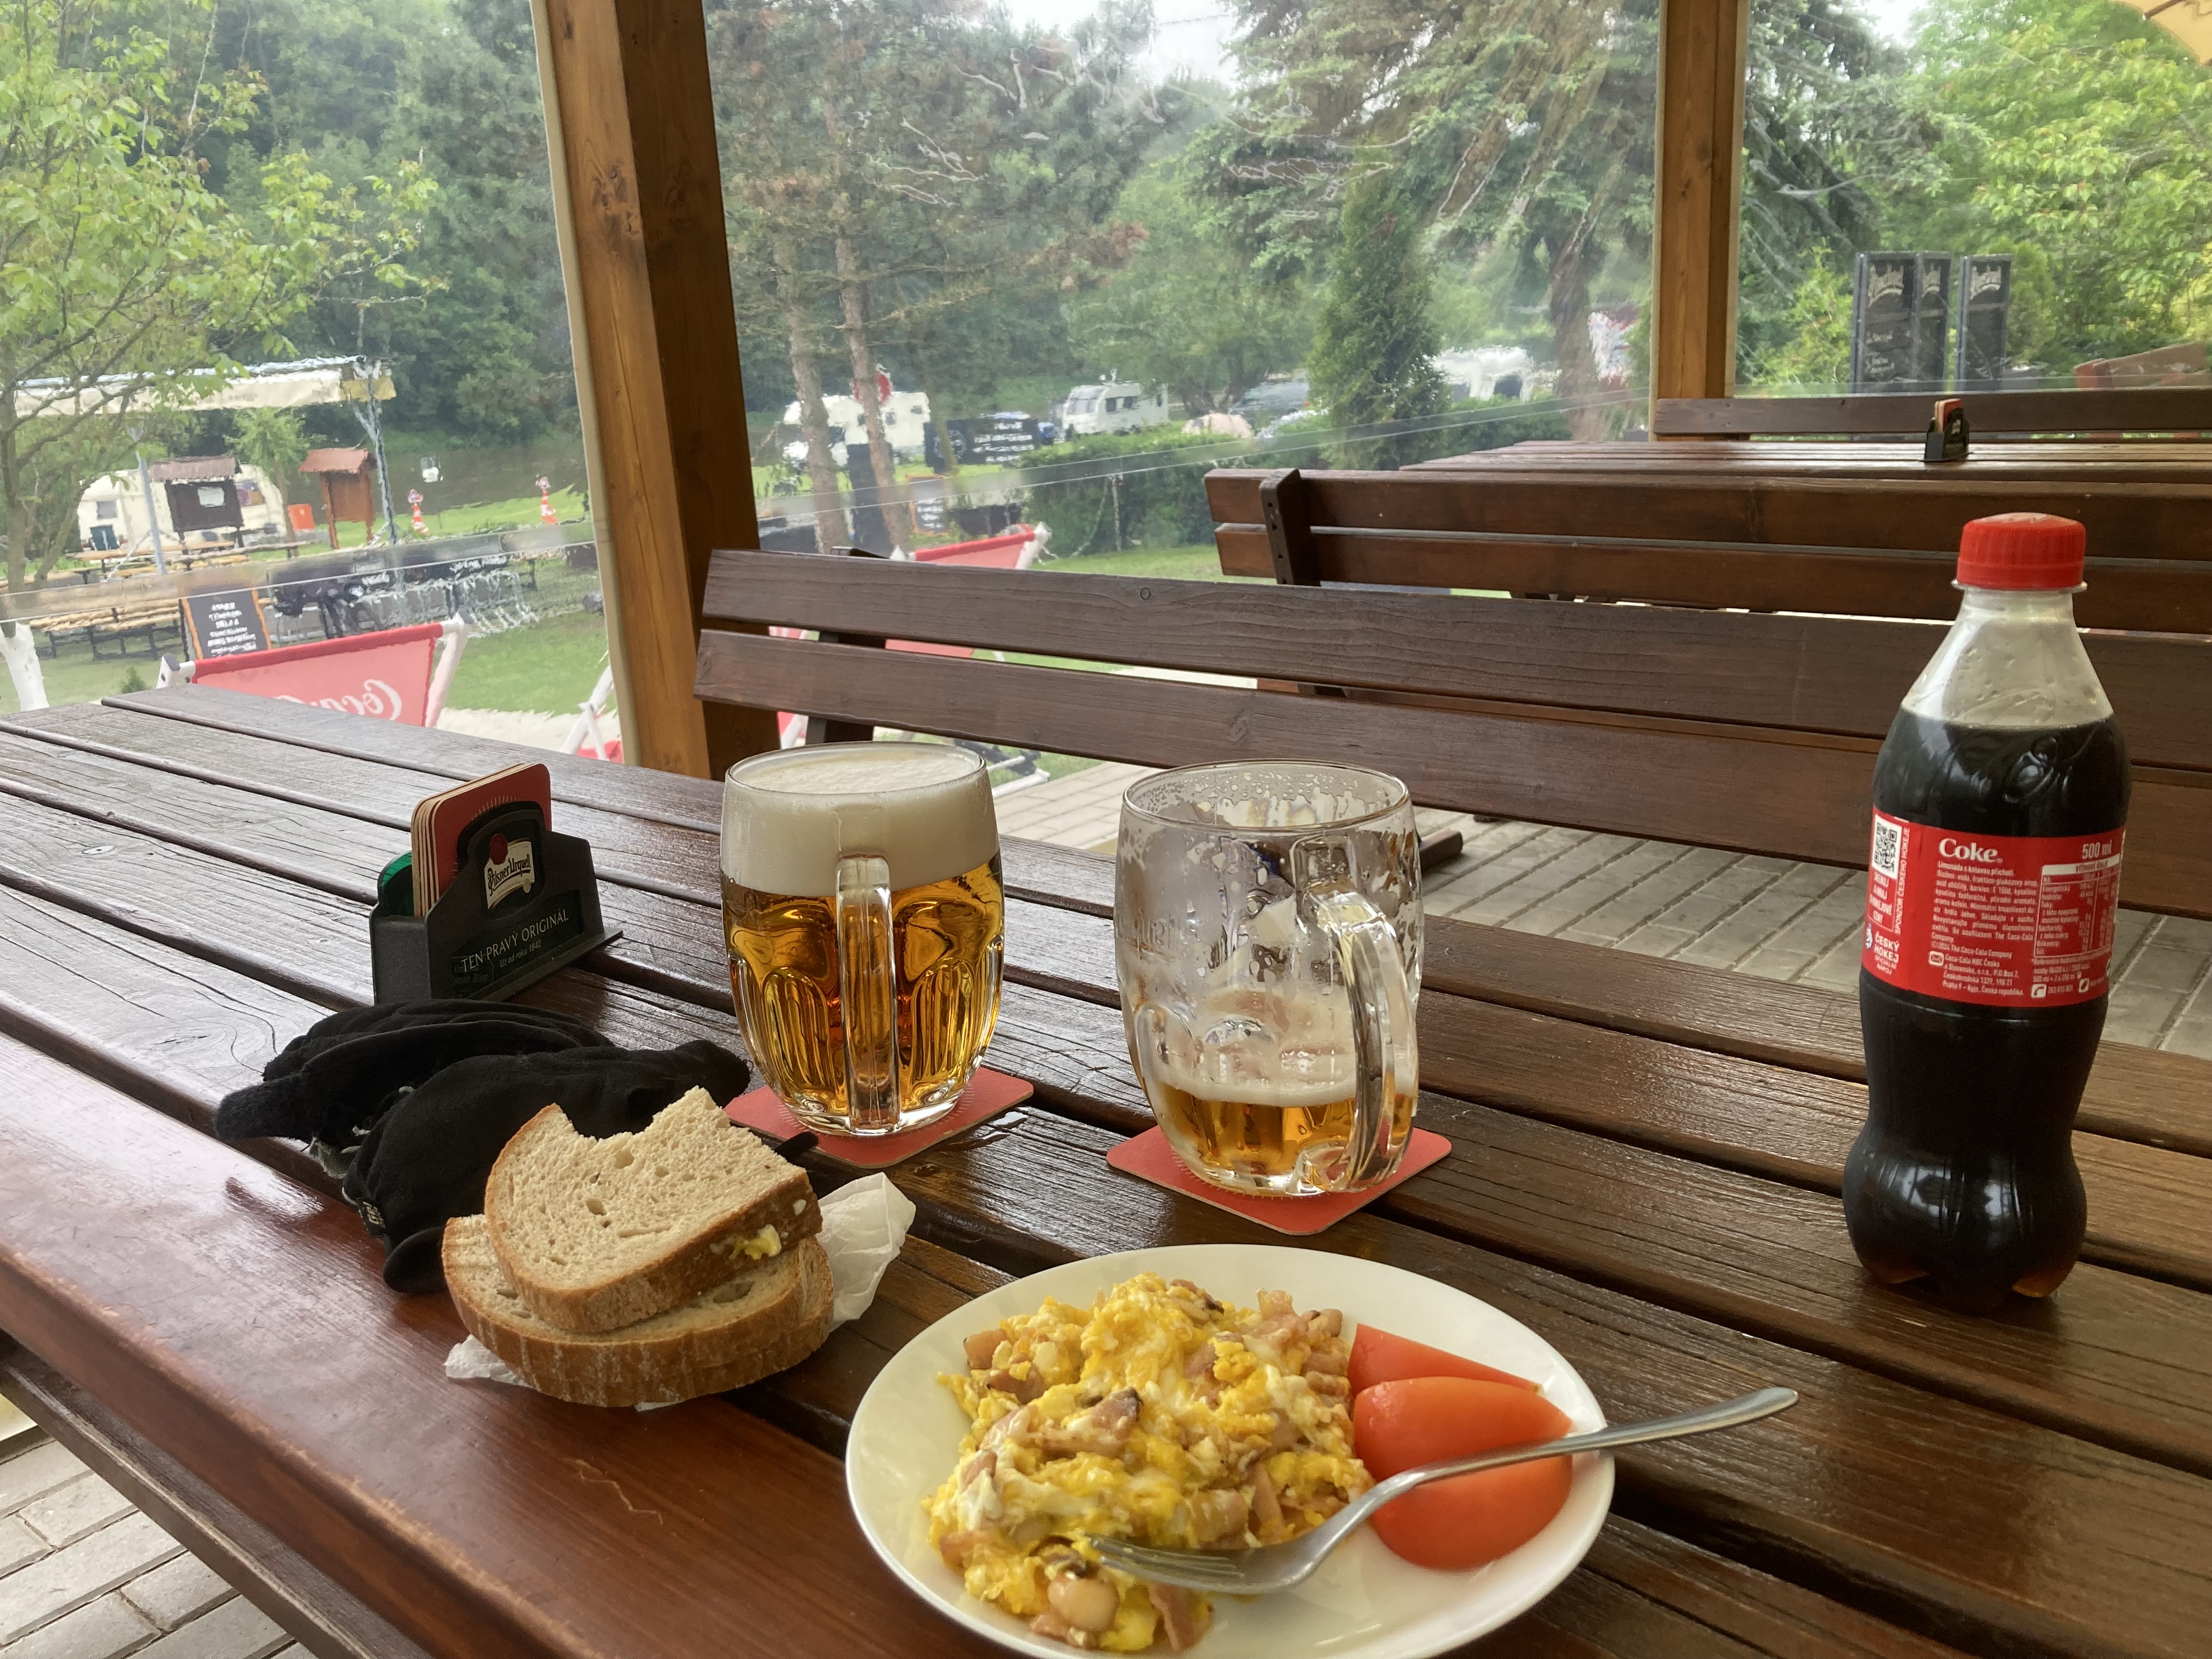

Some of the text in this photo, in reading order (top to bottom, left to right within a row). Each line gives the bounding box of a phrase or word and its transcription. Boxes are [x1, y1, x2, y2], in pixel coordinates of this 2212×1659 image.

[1939, 838, 1998, 862] Coke
[2083, 839, 2112, 859] 500 ml
[487, 854, 532, 897] Pilsner Urquell
[461, 908, 569, 972] TEN PRAVÝ ORIGINÁL
[508, 952, 515, 964] od
[516, 948, 528, 961] roku
[529, 940, 541, 953] 1842
[1875, 931, 1900, 952] ČESKÝ
[1874, 943, 1899, 963] HOKEJ
